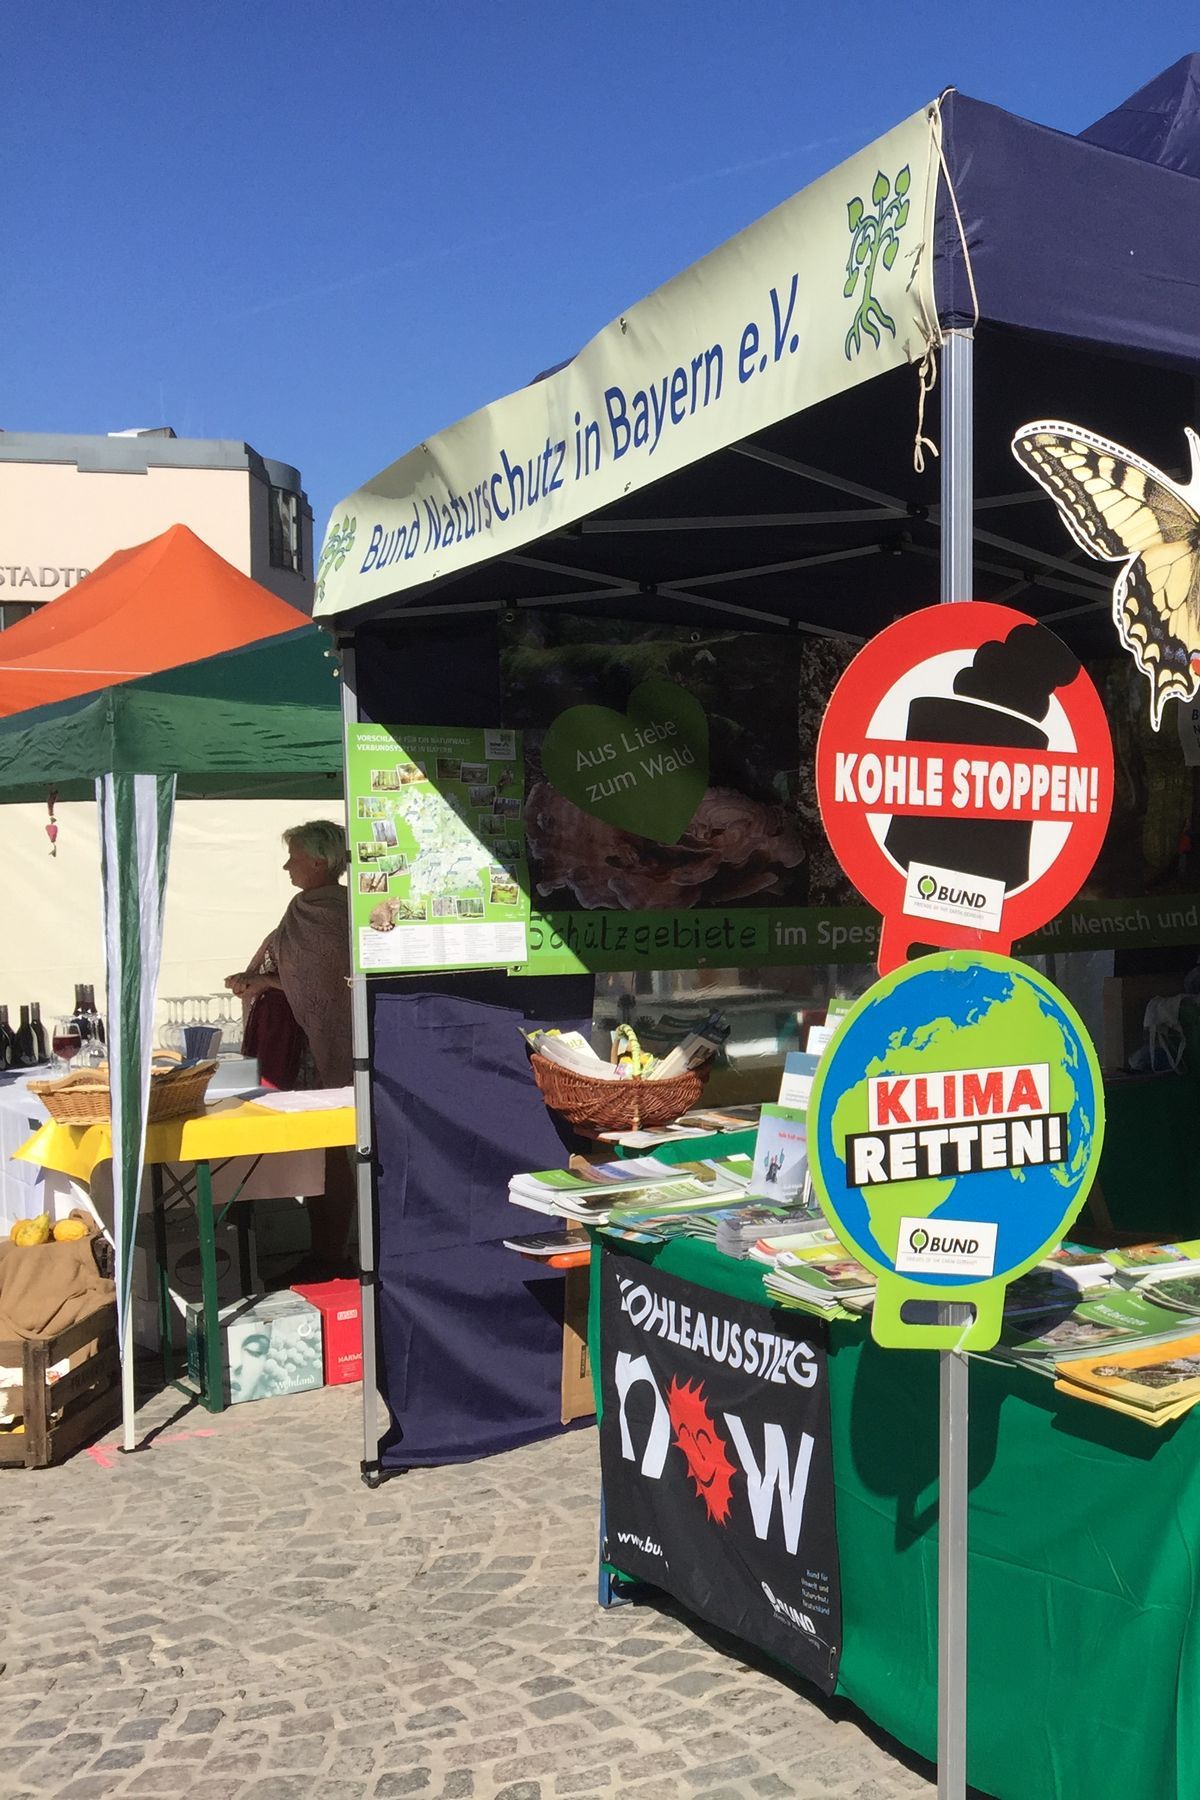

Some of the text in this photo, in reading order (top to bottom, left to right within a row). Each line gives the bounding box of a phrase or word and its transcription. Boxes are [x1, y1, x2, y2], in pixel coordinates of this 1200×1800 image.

[359, 273, 801, 575] Bund Naturschutz in Bayern e.V.
[576, 719, 678, 771] Aus Liebe
[585, 744, 695, 802] zum Wald
[835, 752, 1099, 813] KOHLE STOPPEN!
[937, 886, 987, 909] BUND
[1071, 904, 1151, 934] Mensch
[1157, 901, 1199, 929] und
[775, 921, 806, 946] im
[876, 1068, 1042, 1126] KLIMA
[853, 1116, 1063, 1185] RETTEN!
[929, 1237, 979, 1255] BUND
